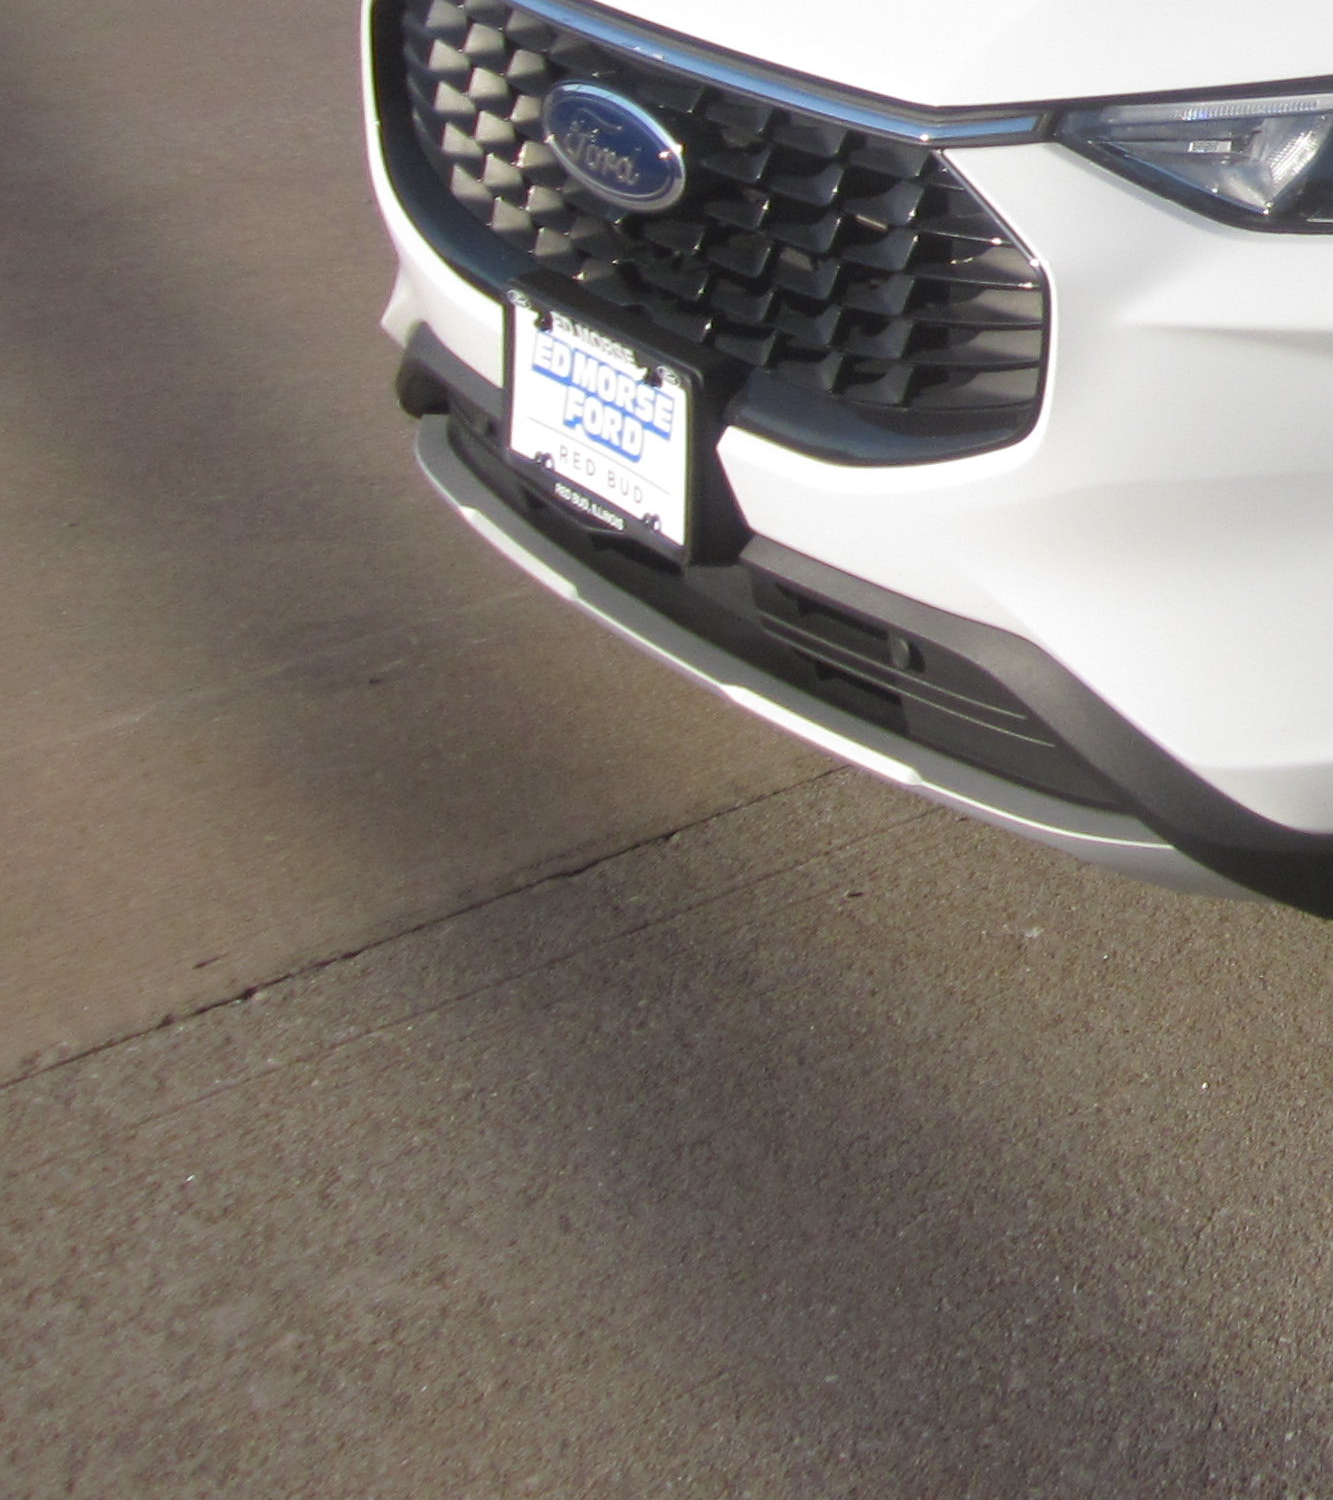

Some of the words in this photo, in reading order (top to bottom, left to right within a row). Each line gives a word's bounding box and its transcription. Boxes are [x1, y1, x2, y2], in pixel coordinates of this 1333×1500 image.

[564, 107, 643, 186] Ford
[532, 330, 572, 386] ED
[571, 347, 675, 442] MORSE
[564, 385, 645, 463] FORD
[559, 444, 597, 476] RED
[607, 470, 644, 504] BUD
